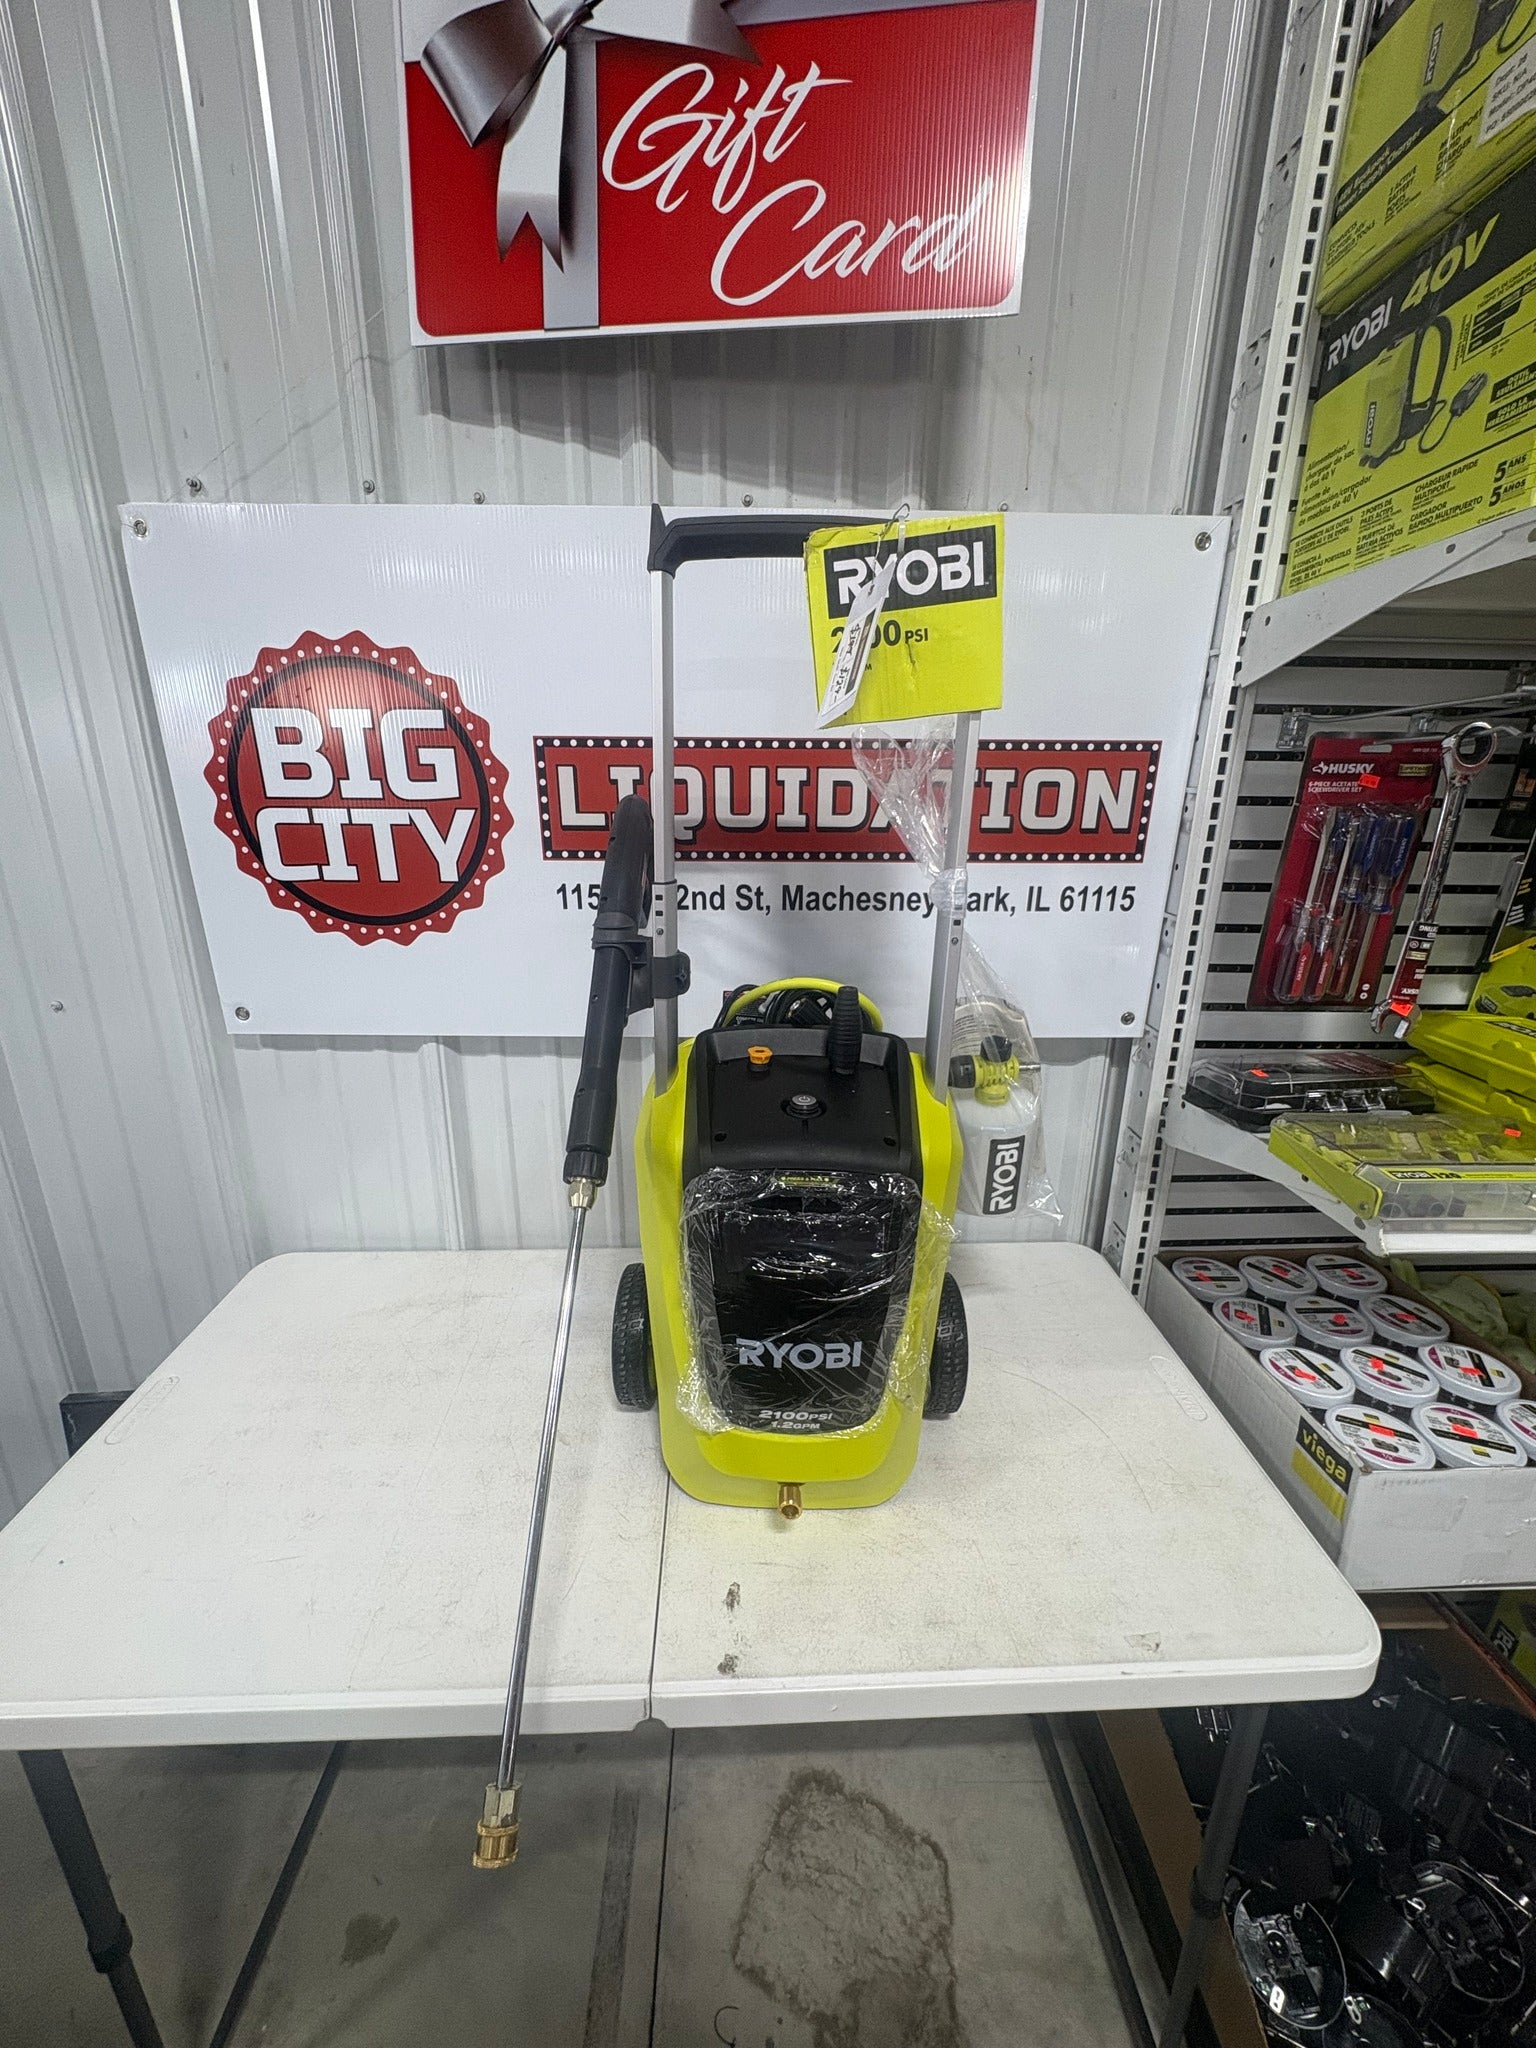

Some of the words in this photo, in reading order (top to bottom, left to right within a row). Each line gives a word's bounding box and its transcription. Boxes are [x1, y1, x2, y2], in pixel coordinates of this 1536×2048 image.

[603, 61, 853, 213] Gift
[711, 175, 993, 306] Card
[1327, 296, 1393, 371] RYOBI
[1400, 213, 1500, 313] 40V
[1366, 403, 1375, 446] RYOBI
[1414, 471, 1451, 494] CHARGEUR
[1452, 459, 1479, 478] RAPIDE
[1494, 461, 1507, 483] 5
[1507, 454, 1527, 468] ANS
[1410, 501, 1447, 522] CARGADOR
[1488, 485, 1503, 507] 5
[250, 707, 462, 801] BIG
[1328, 763, 1375, 774] HUSKY
[254, 807, 478, 883] CITY
[676, 883, 725, 911] 2nd
[735, 884, 772, 915] St,
[781, 884, 935, 918] Machesney
[966, 886, 1016, 917] ark,
[1026, 886, 1050, 912] IL
[1058, 885, 1136, 912] 61115
[990, 1142, 1020, 1211] RYOBI
[1393, 1171, 1433, 1179] RYOBI
[736, 1338, 863, 1369] RYOBI
[1302, 1428, 1347, 1483] viega
